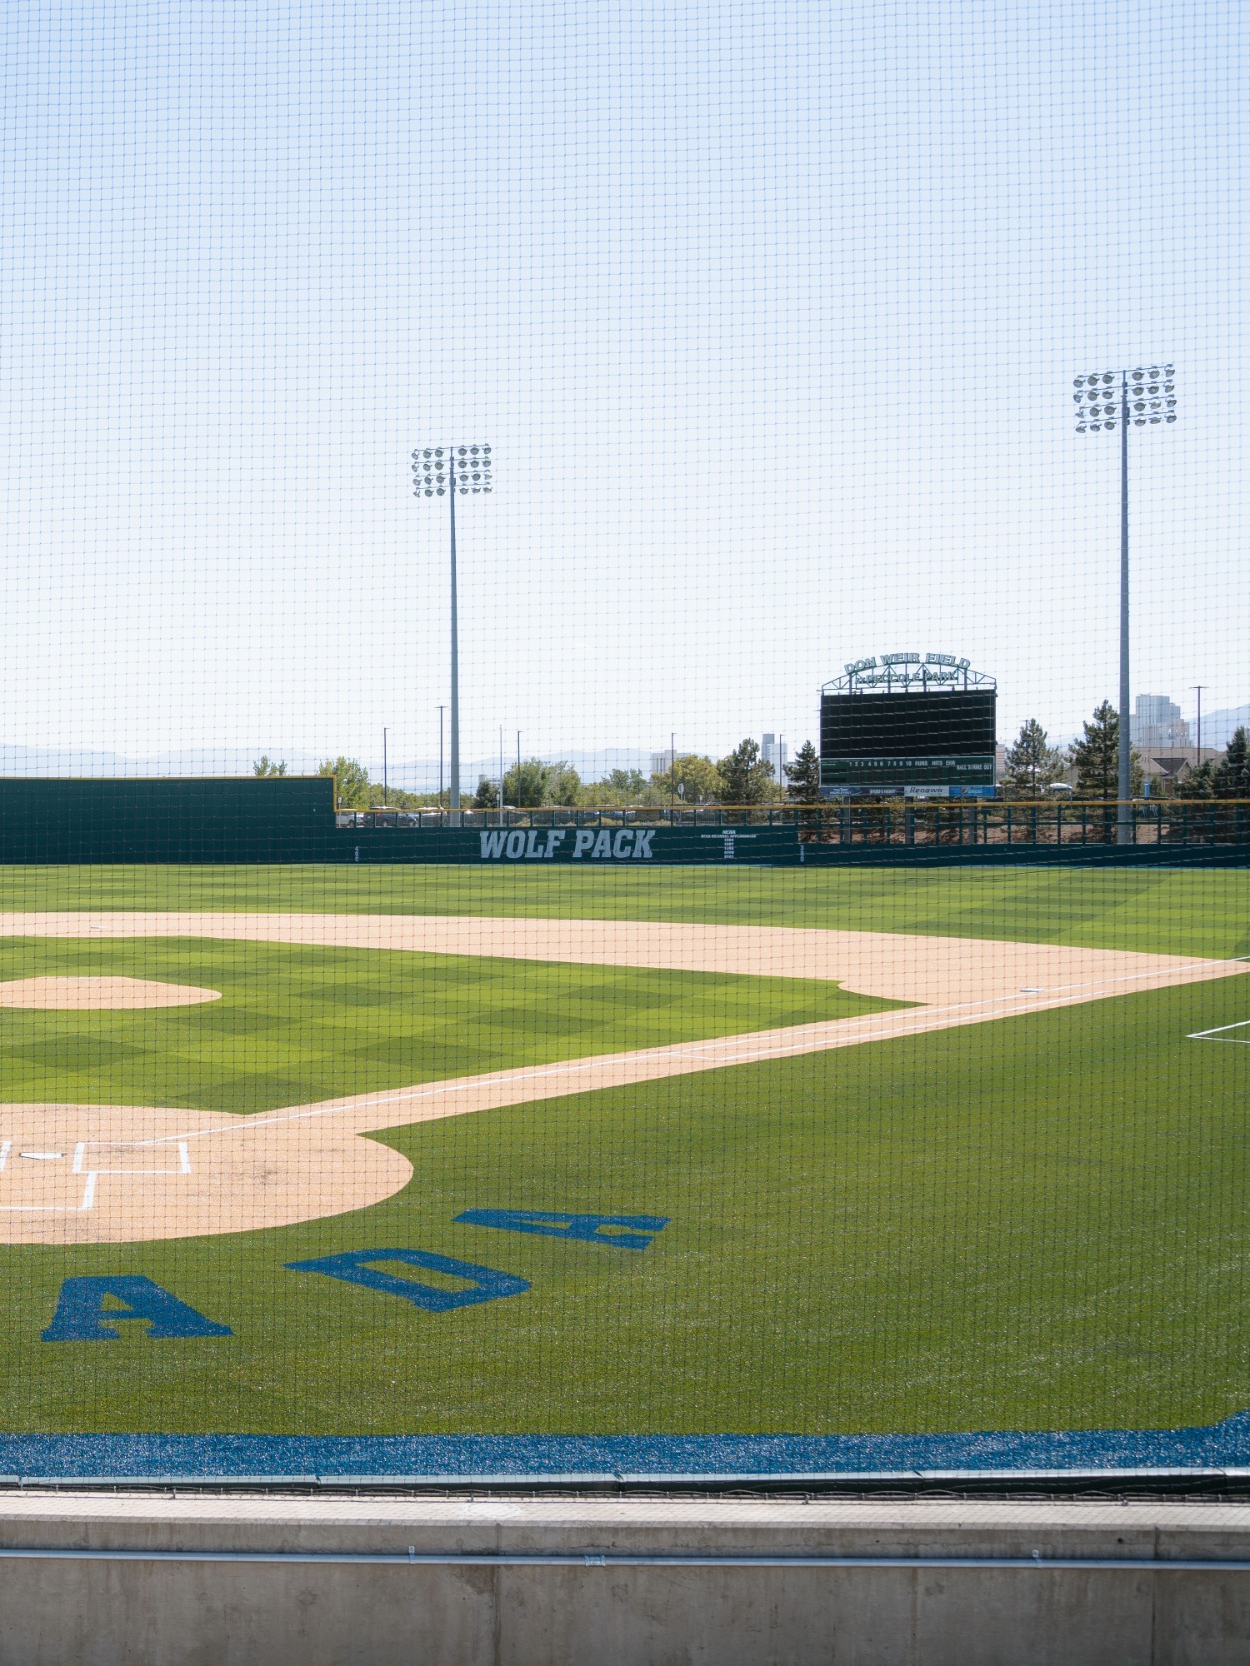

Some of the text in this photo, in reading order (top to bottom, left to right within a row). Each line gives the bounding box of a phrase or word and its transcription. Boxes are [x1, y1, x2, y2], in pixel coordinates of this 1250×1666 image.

[844, 652, 971, 675] DON WEIR FIELD
[866, 673, 921, 683] PECCOLE
[924, 671, 958, 681] PARK
[479, 829, 656, 859] WOLF PACK
